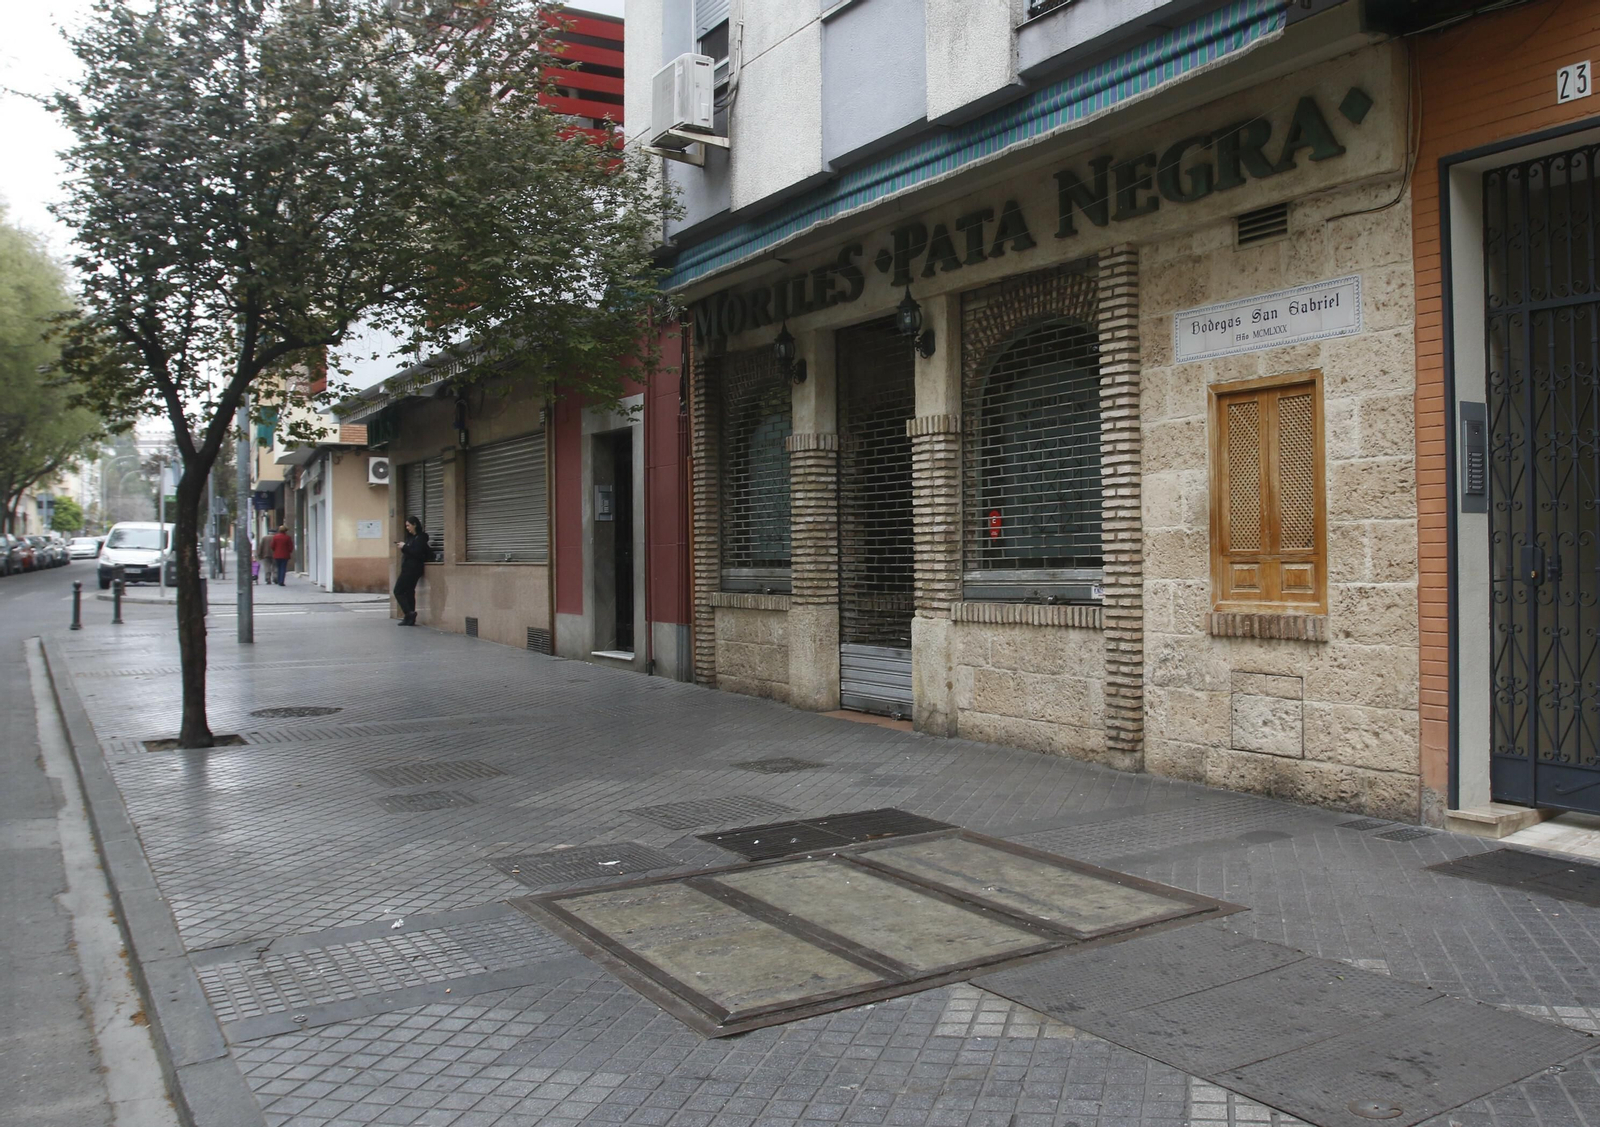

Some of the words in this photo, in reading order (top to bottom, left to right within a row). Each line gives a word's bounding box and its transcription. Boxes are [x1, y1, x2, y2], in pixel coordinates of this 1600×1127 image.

[1560, 64, 1587, 99] 23
[693, 243, 865, 344] MORILES
[890, 200, 1036, 286] PATA
[1053, 97, 1346, 238] NEGRA
[1191, 316, 1242, 335] Bodegas
[1252, 308, 1278, 324] San
[1289, 291, 1340, 316] Gabriel
[1252, 323, 1288, 340] MCMLXXX
